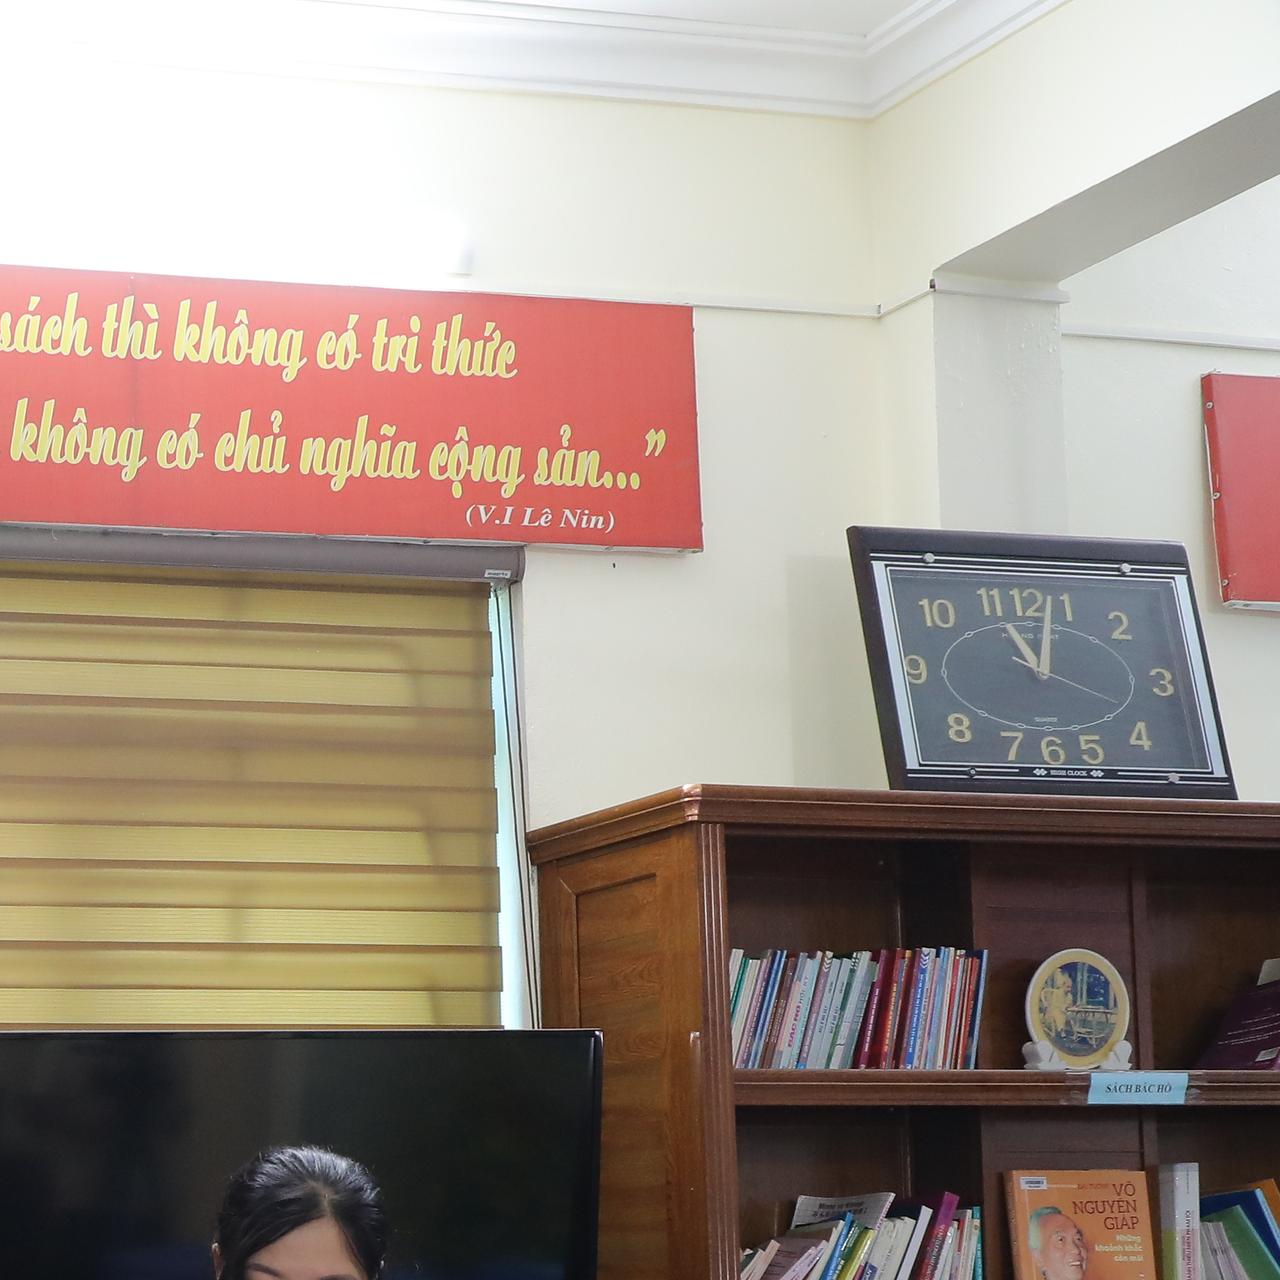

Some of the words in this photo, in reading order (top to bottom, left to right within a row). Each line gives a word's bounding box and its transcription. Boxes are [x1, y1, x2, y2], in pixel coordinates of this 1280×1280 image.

[101, 294, 162, 360] thì
[173, 298, 307, 383] không
[317, 313, 362, 371] có
[432, 313, 518, 379] thức
[10, 397, 147, 483] không
[157, 413, 204, 470] có
[214, 409, 290, 474] chủ
[300, 415, 420, 491] nghĩa
[429, 426, 525, 499] cộng
[465, 504, 515, 528] (V.I
[521, 507, 553, 527] Lê
[560, 508, 616, 534] Nin)
[919, 599, 956, 628] 10
[977, 588, 1004, 616] 11
[1009, 589, 1044, 617] 12
[1060, 593, 1074, 622] 1
[1108, 612, 1132, 640] 2
[905, 655, 928, 684] 9
[1149, 669, 1175, 697] 3
[948, 713, 972, 742] 8
[1130, 722, 1152, 751] 4
[1000, 732, 1024, 761] 7
[1041, 737, 1066, 765] 6
[1079, 736, 1105, 764] 5
[1105, 1082, 1133, 1094] SÁCH
[1135, 1081, 1156, 1093] BÁC
